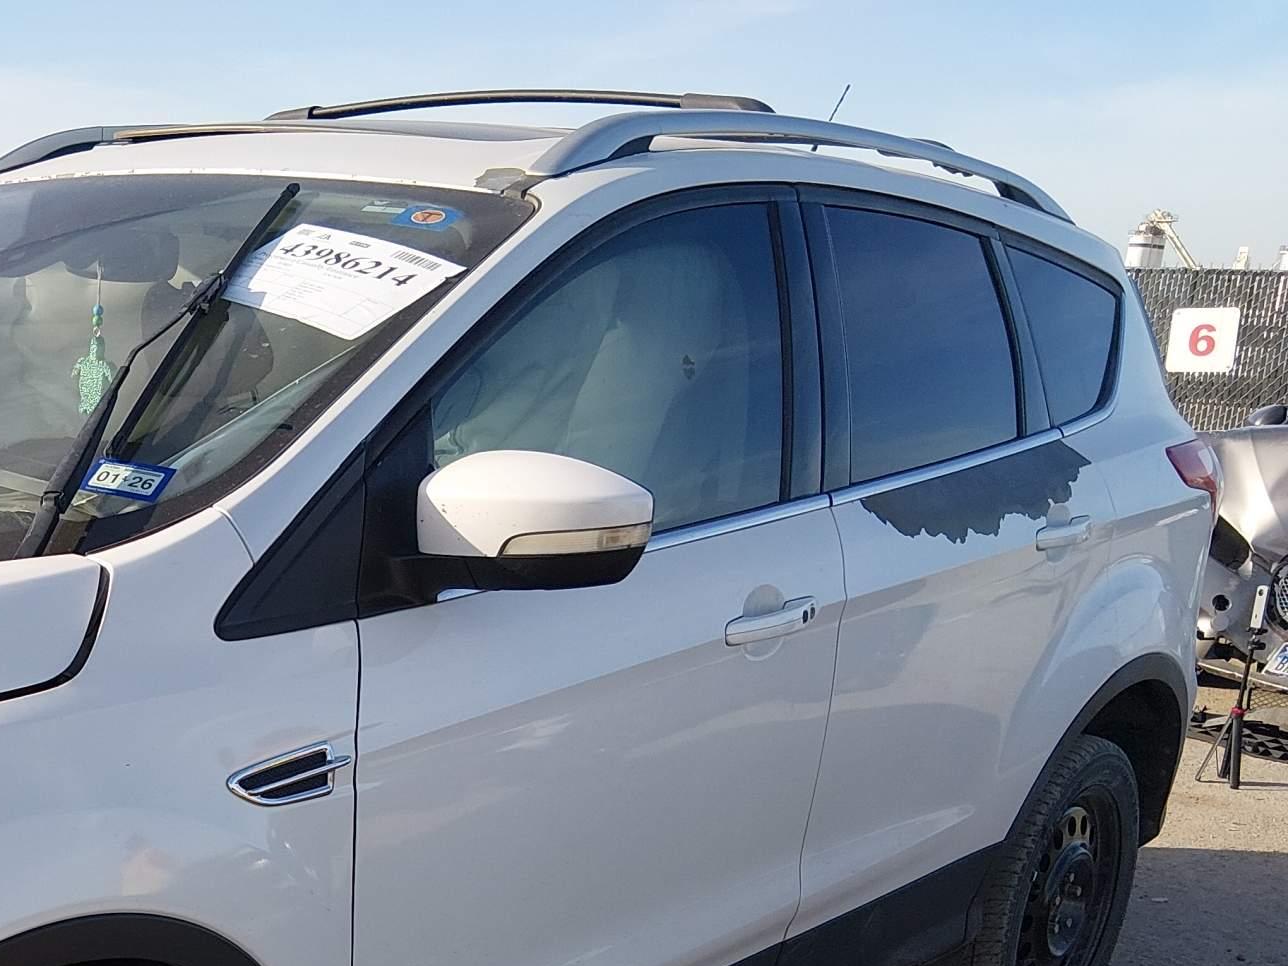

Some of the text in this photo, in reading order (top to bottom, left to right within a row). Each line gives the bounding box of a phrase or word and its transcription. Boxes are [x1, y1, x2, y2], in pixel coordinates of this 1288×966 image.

[279, 242, 418, 287] 43986214
[1188, 323, 1217, 357] 6
[96, 470, 121, 484] 01
[127, 476, 156, 490] 26
